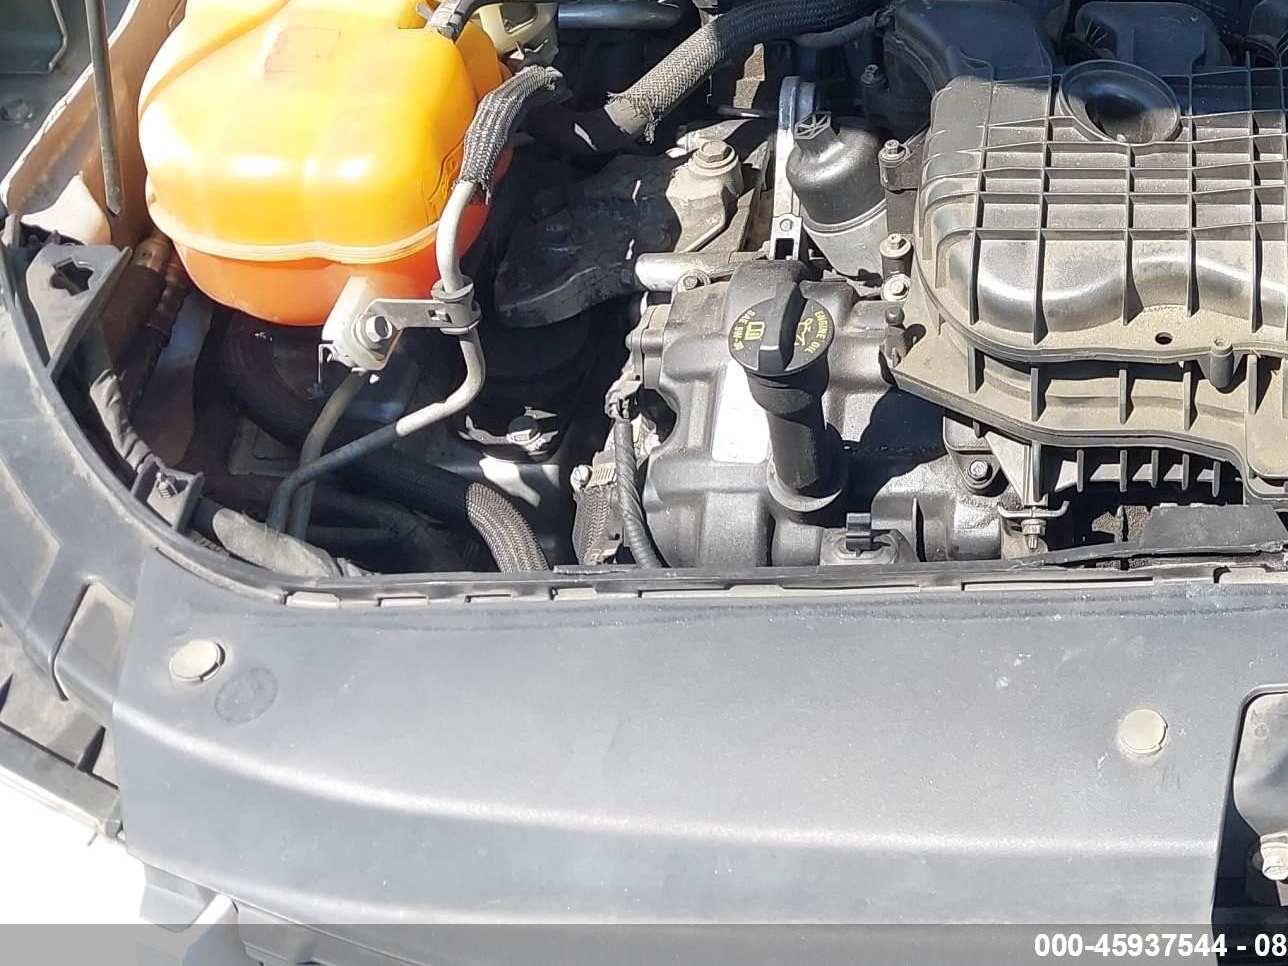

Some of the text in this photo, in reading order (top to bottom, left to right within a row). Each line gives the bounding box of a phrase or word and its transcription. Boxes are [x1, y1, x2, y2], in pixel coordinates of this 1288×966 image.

[739, 309, 756, 325] SAE
[804, 310, 828, 354] ENGINE OIL
